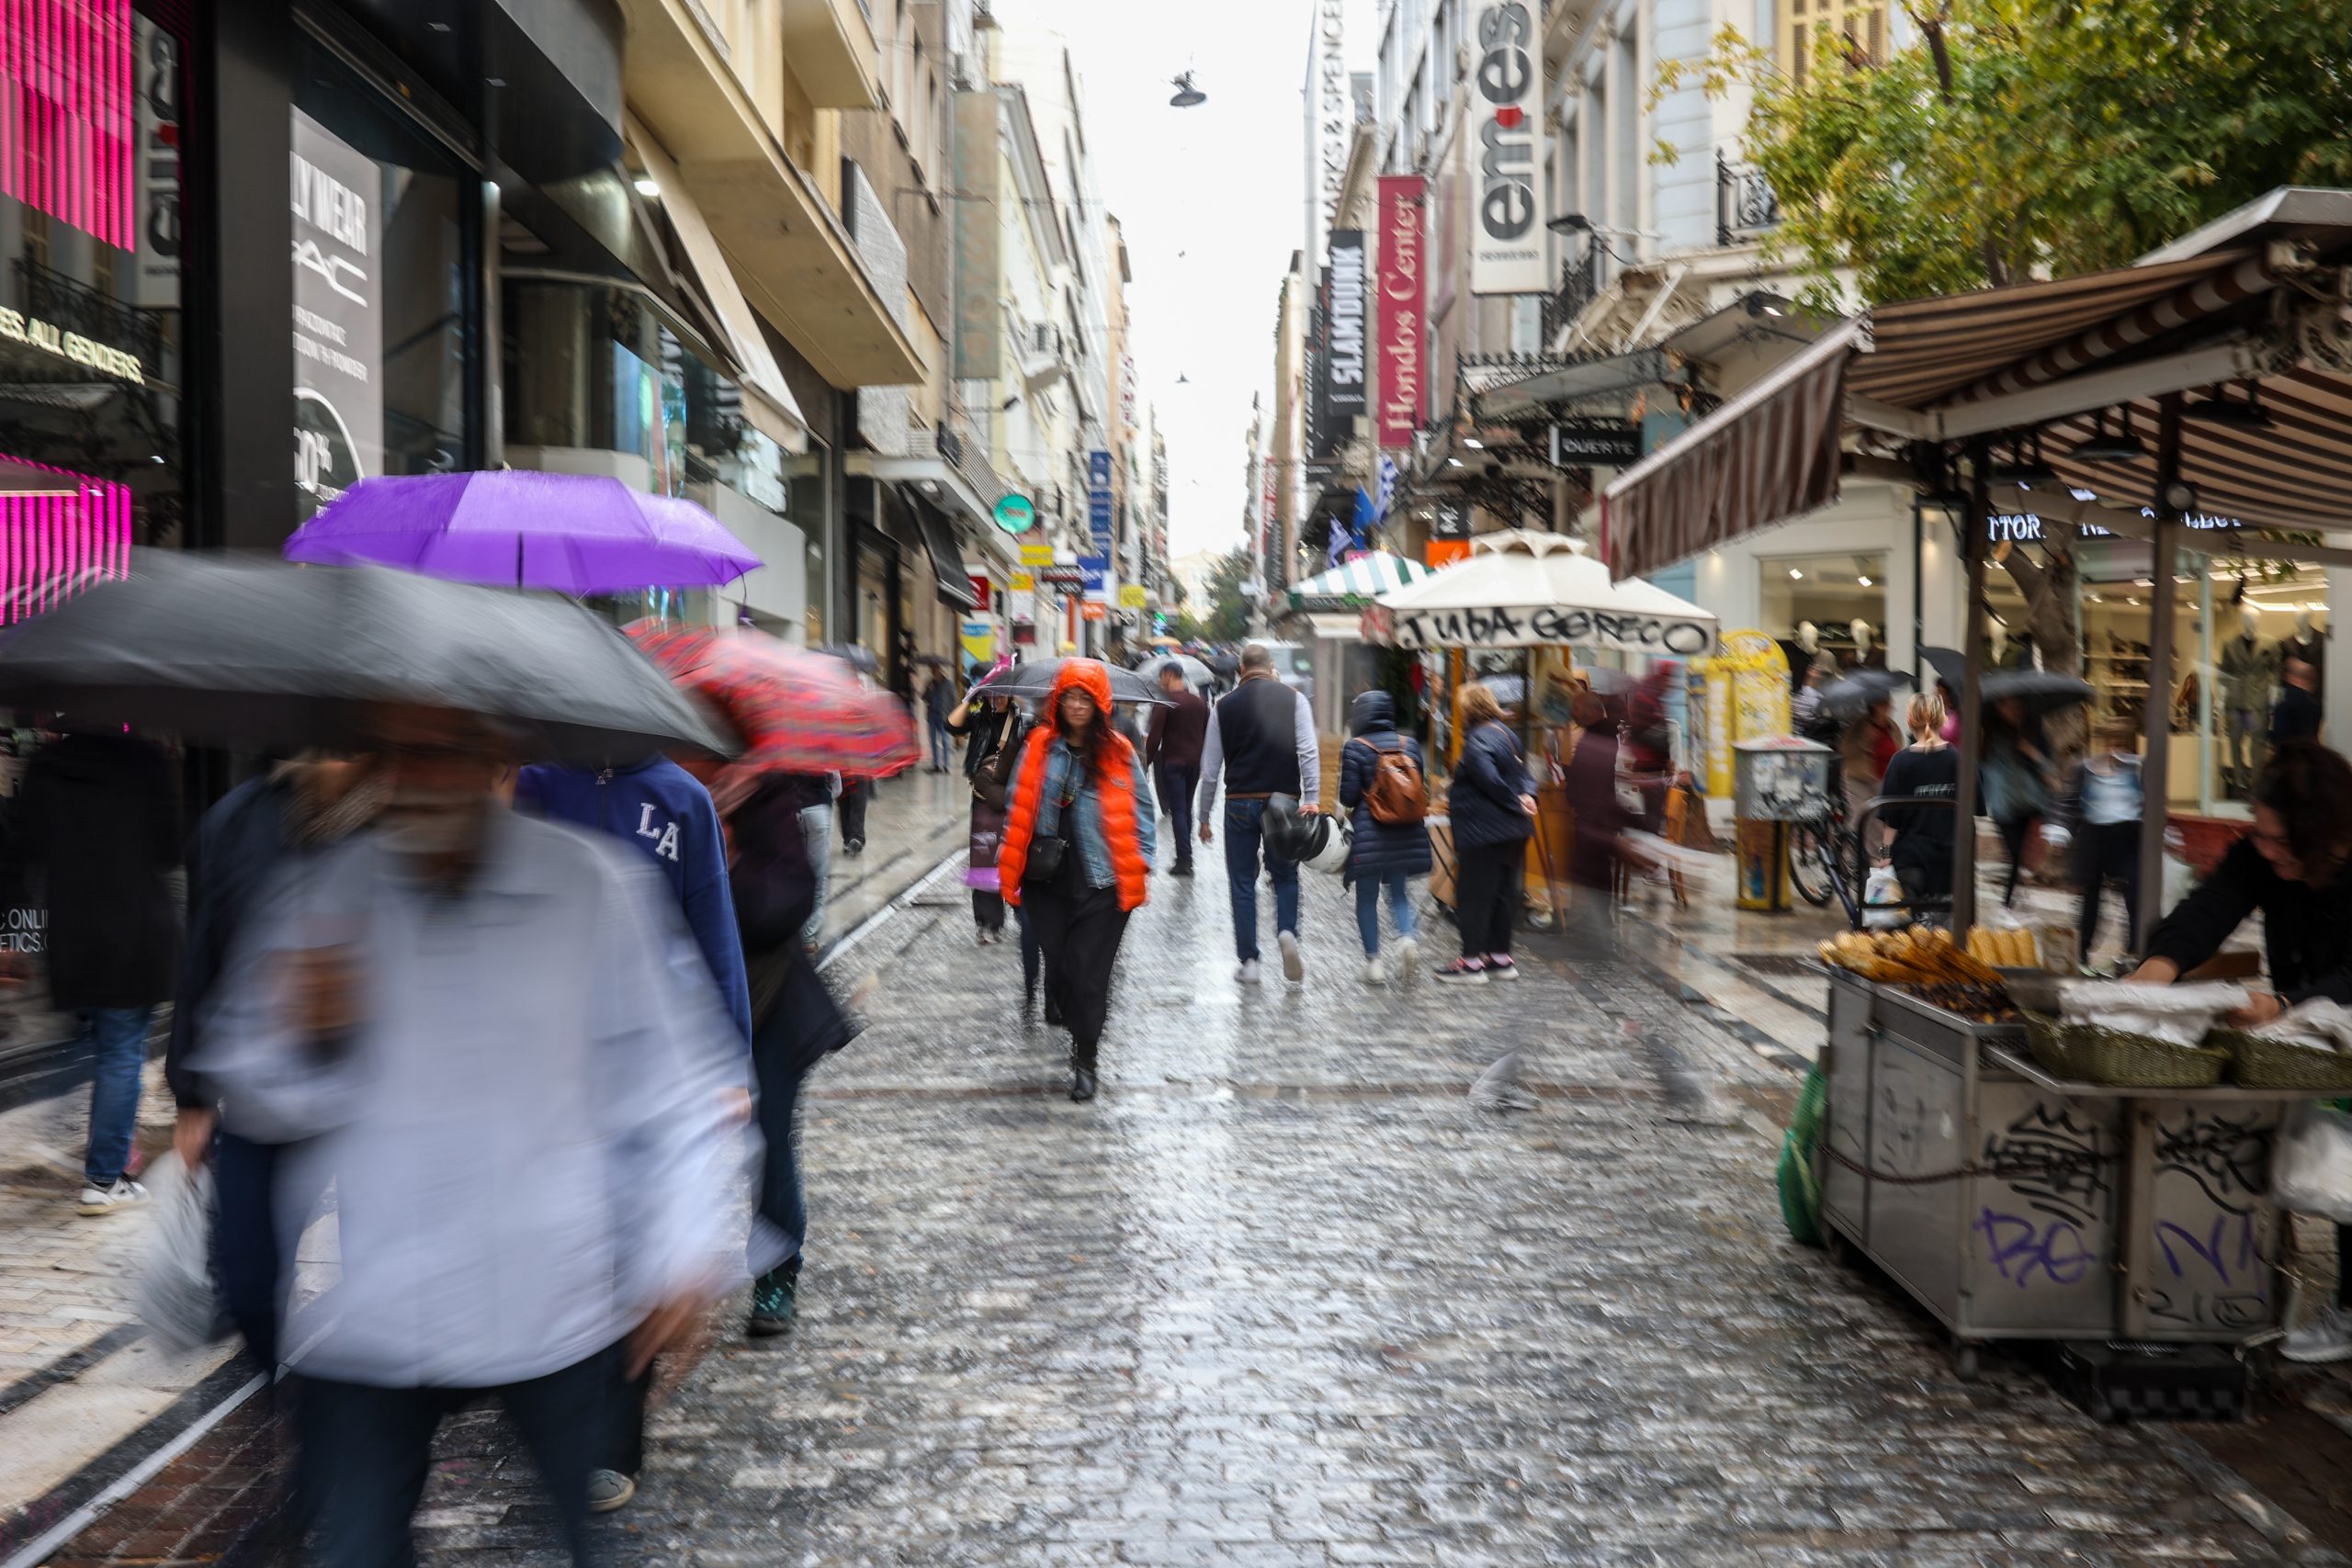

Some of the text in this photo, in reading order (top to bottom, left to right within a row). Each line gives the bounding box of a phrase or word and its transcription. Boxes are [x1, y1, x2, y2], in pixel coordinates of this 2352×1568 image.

[1321, 0, 1344, 115] SPENCE
[1330, 244, 1363, 385] SLAMDUNK
[1384, 192, 1419, 433] Hondos Center
[636, 802, 680, 863] LA
[8, 908, 49, 930] ONLI
